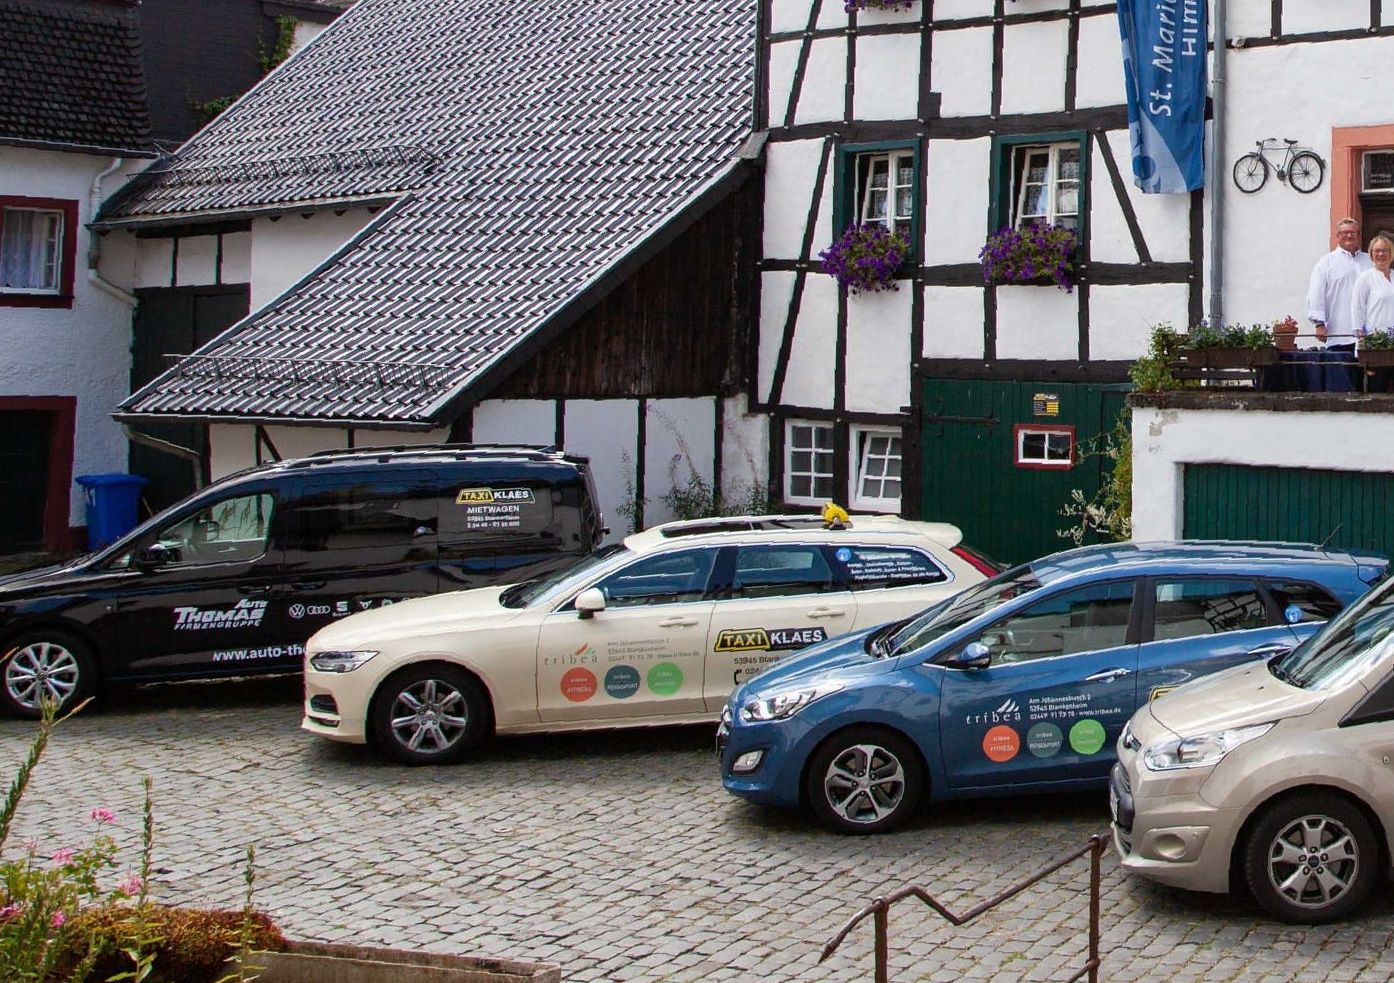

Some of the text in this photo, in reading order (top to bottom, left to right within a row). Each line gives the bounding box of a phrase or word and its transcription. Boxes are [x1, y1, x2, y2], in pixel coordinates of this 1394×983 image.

[1150, 83, 1172, 117] St.
[464, 490, 529, 500] TAXI KLAES
[467, 505, 520, 514] MIETWAGEN
[723, 630, 822, 646] TAXI KLAES
[213, 644, 306, 661] www.auto-th
[544, 654, 598, 666] tribea
[966, 711, 1021, 725] tribea
